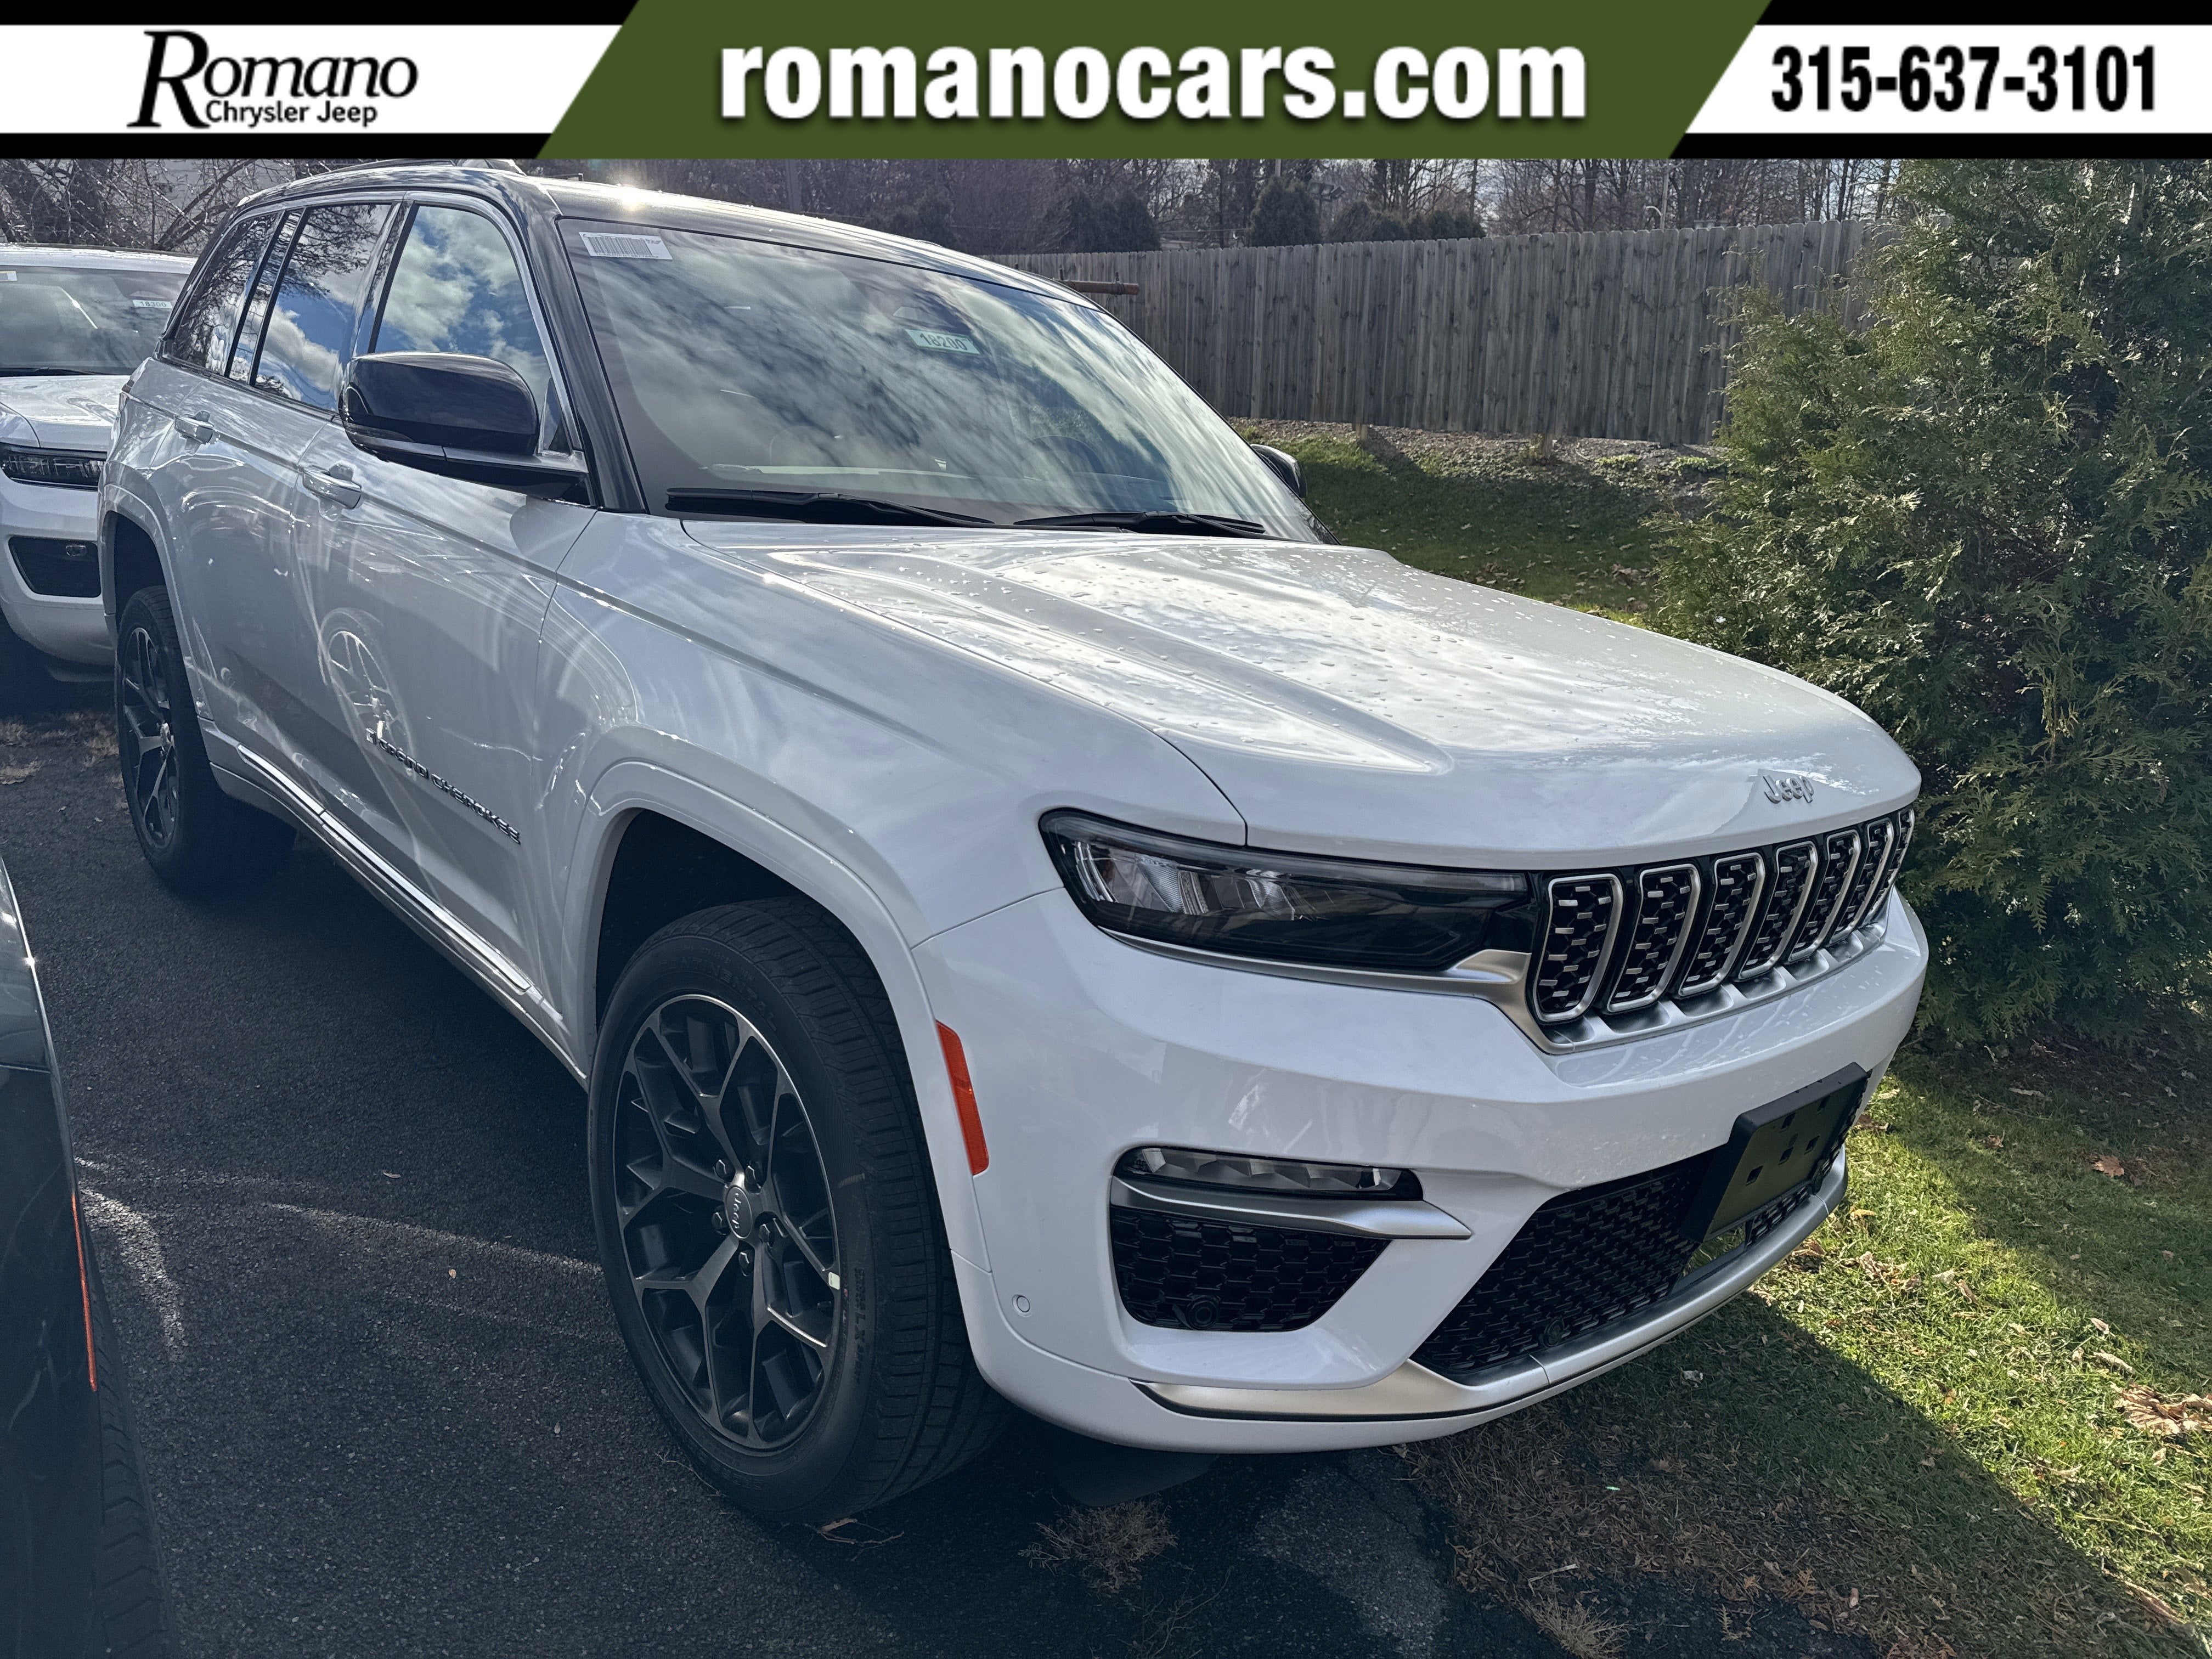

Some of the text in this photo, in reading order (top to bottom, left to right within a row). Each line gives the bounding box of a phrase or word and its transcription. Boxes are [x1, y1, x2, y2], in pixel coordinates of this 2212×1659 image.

[920, 333, 968, 351] 18200
[1763, 775, 1814, 804] Jeep
[732, 1193, 742, 1229] Jeep
